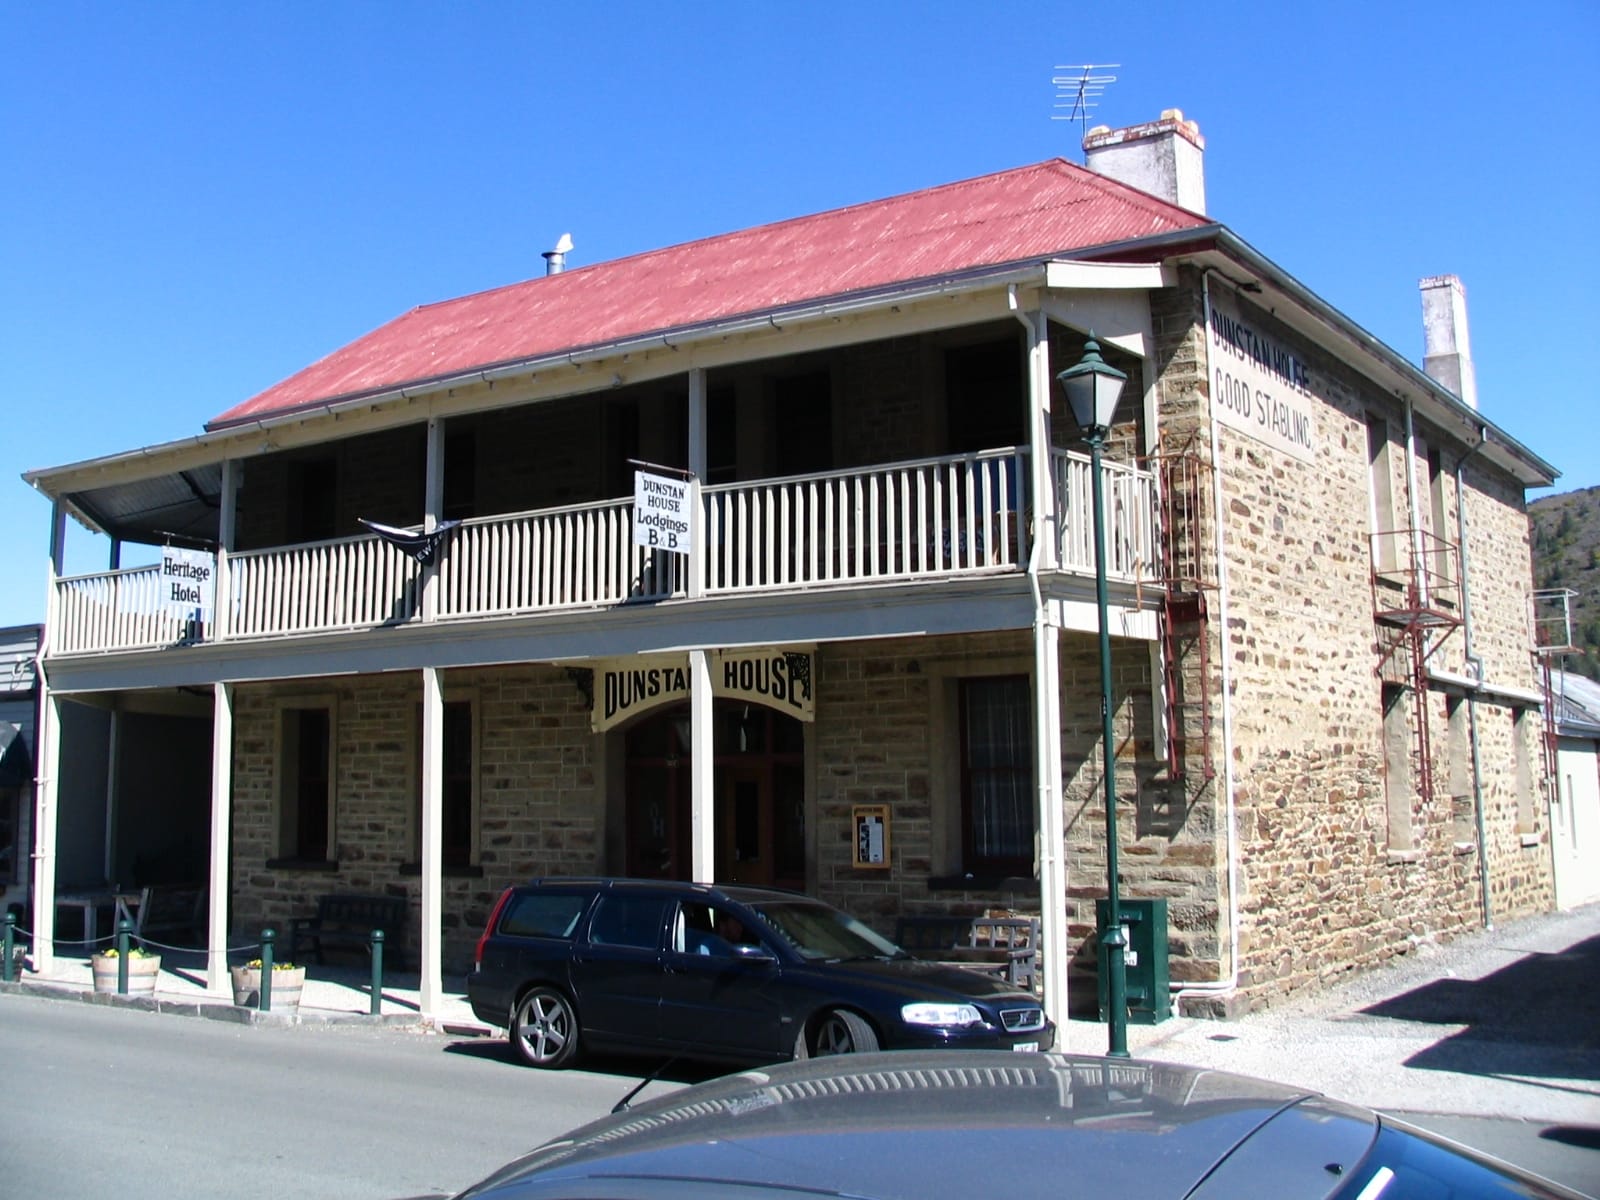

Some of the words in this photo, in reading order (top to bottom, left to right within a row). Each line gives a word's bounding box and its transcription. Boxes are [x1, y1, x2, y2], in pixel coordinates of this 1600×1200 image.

[1211, 309, 1271, 377] DUNSTAN
[643, 479, 685, 500] DUNSTAN
[647, 495, 681, 513] HOUSE
[637, 507, 688, 533] Lodgings
[163, 556, 211, 582] Heritage
[171, 582, 202, 604] Hotel
[605, 667, 691, 720] DUNSTA
